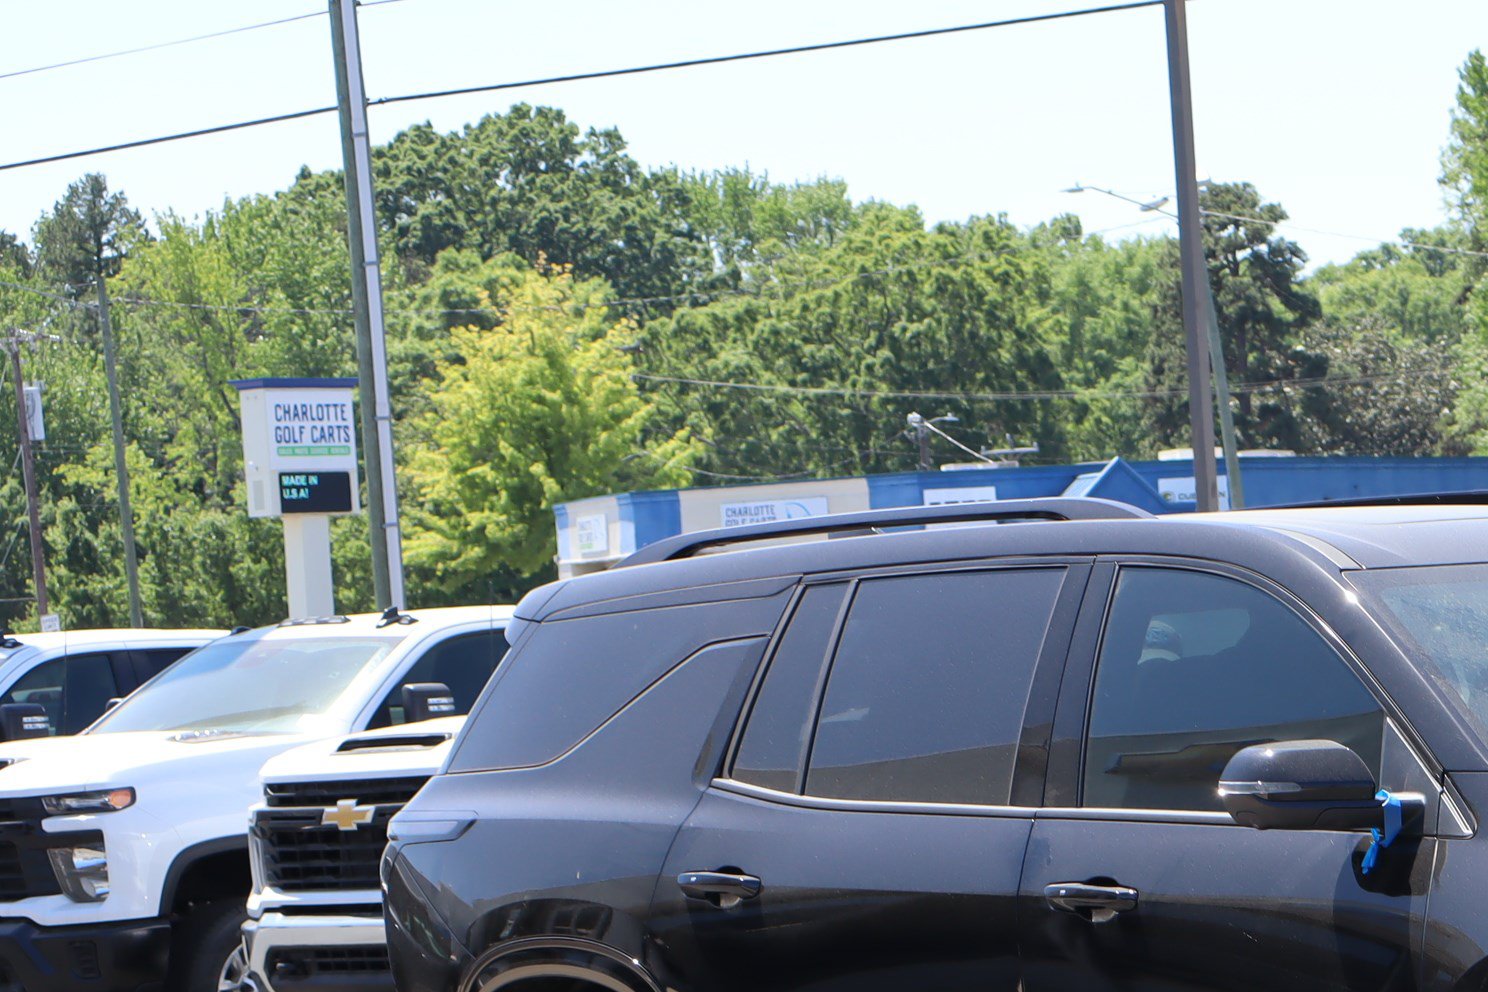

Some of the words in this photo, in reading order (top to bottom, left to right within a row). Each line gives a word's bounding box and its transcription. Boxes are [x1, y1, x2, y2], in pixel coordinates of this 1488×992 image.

[274, 403, 347, 422] CHARLOTTE
[274, 426, 305, 444] GOLF
[311, 425, 351, 444] CARTS
[281, 475, 307, 486] MADE
[308, 475, 319, 486] IN
[725, 504, 776, 517] CHARLOTTE
